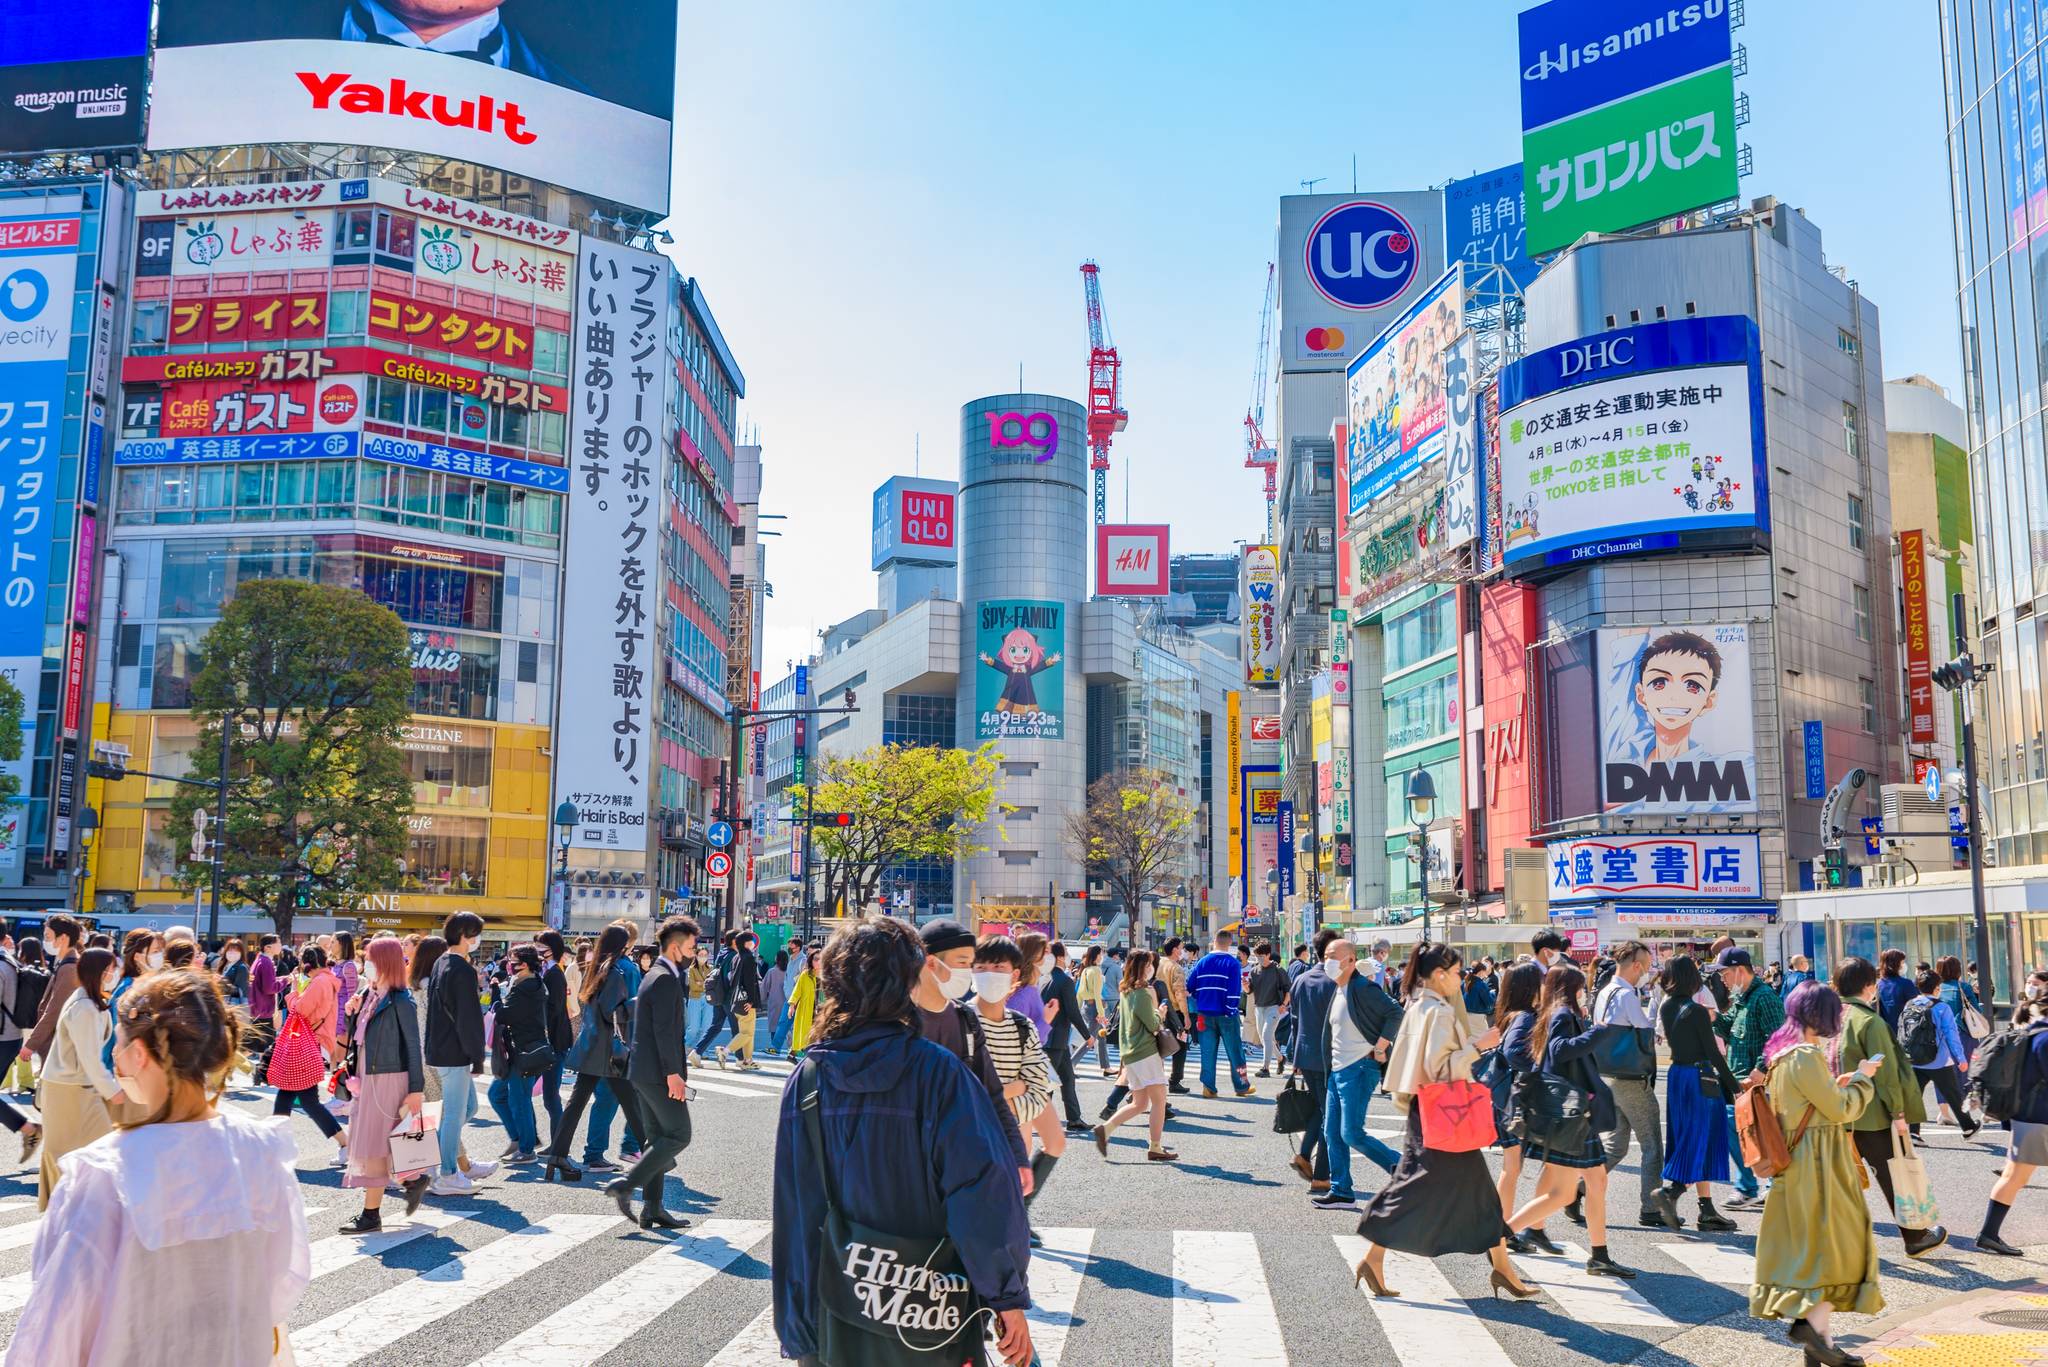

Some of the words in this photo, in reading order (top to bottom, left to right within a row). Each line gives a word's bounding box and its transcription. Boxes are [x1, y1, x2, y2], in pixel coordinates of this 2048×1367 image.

[1524, 0, 1724, 80] Hisamitsu
[15, 90, 74, 108] amazon
[77, 84, 128, 102] music
[83, 104, 121, 114] UNLIMITED
[296, 72, 537, 145] Yakult
[1537, 111, 1721, 212] サロンパス
[161, 183, 325, 210] しゃぶしゃぶバイキング
[405, 188, 571, 246] しゃぶしゃぶバイキング
[143, 237, 171, 257] 9F
[230, 221, 323, 256] しゃぶ葉
[472, 243, 567, 292] しゃぶ葉
[174, 298, 321, 335] プライス
[371, 297, 527, 356] コンタクト
[260, 350, 334, 380] ガスト
[1560, 335, 1634, 378] DHC
[481, 375, 552, 411] ガスト
[580, 252, 619, 512] いい曲あります。
[127, 402, 162, 426] 7F
[169, 400, 209, 418] Café
[169, 418, 208, 429] レストラン
[212, 392, 306, 433] ガスト
[323, 401, 354, 414] ガスト
[1509, 384, 1723, 445] 春の交通安全運動実施中
[122, 442, 167, 460] AEON
[182, 438, 316, 460] 英会話イーオン
[985, 412, 1058, 463] 109
[371, 438, 420, 461] AEON
[431, 448, 565, 486] 英会話イーオン
[1528, 442, 1691, 486] 世界一の交通安全都市
[1545, 466, 1667, 501] TOKYOを目指して
[5, 401, 49, 608] コンタクトの
[907, 497, 945, 519] UNI
[612, 264, 660, 784] ブラジャーのホックを外す歌より、
[907, 520, 948, 541] QLO
[1115, 548, 1150, 572] H&M
[1572, 546, 1596, 560] DHC
[1597, 539, 1642, 555] Channel
[1905, 535, 1925, 652] クスリのことなら
[1909, 660, 1933, 733] 三千里
[1026, 727, 1040, 735] ON
[1043, 728, 1058, 736] AIR
[572, 792, 633, 807] サブスク解禁
[1606, 760, 1751, 803] DMM
[581, 808, 607, 824] Hair
[608, 810, 618, 825] is
[619, 811, 645, 826] Bad
[586, 832, 600, 840] EMI
[1554, 846, 1741, 888] 大盛堂書店
[843, 1242, 969, 1299] Human
[854, 1281, 960, 1331] Made
